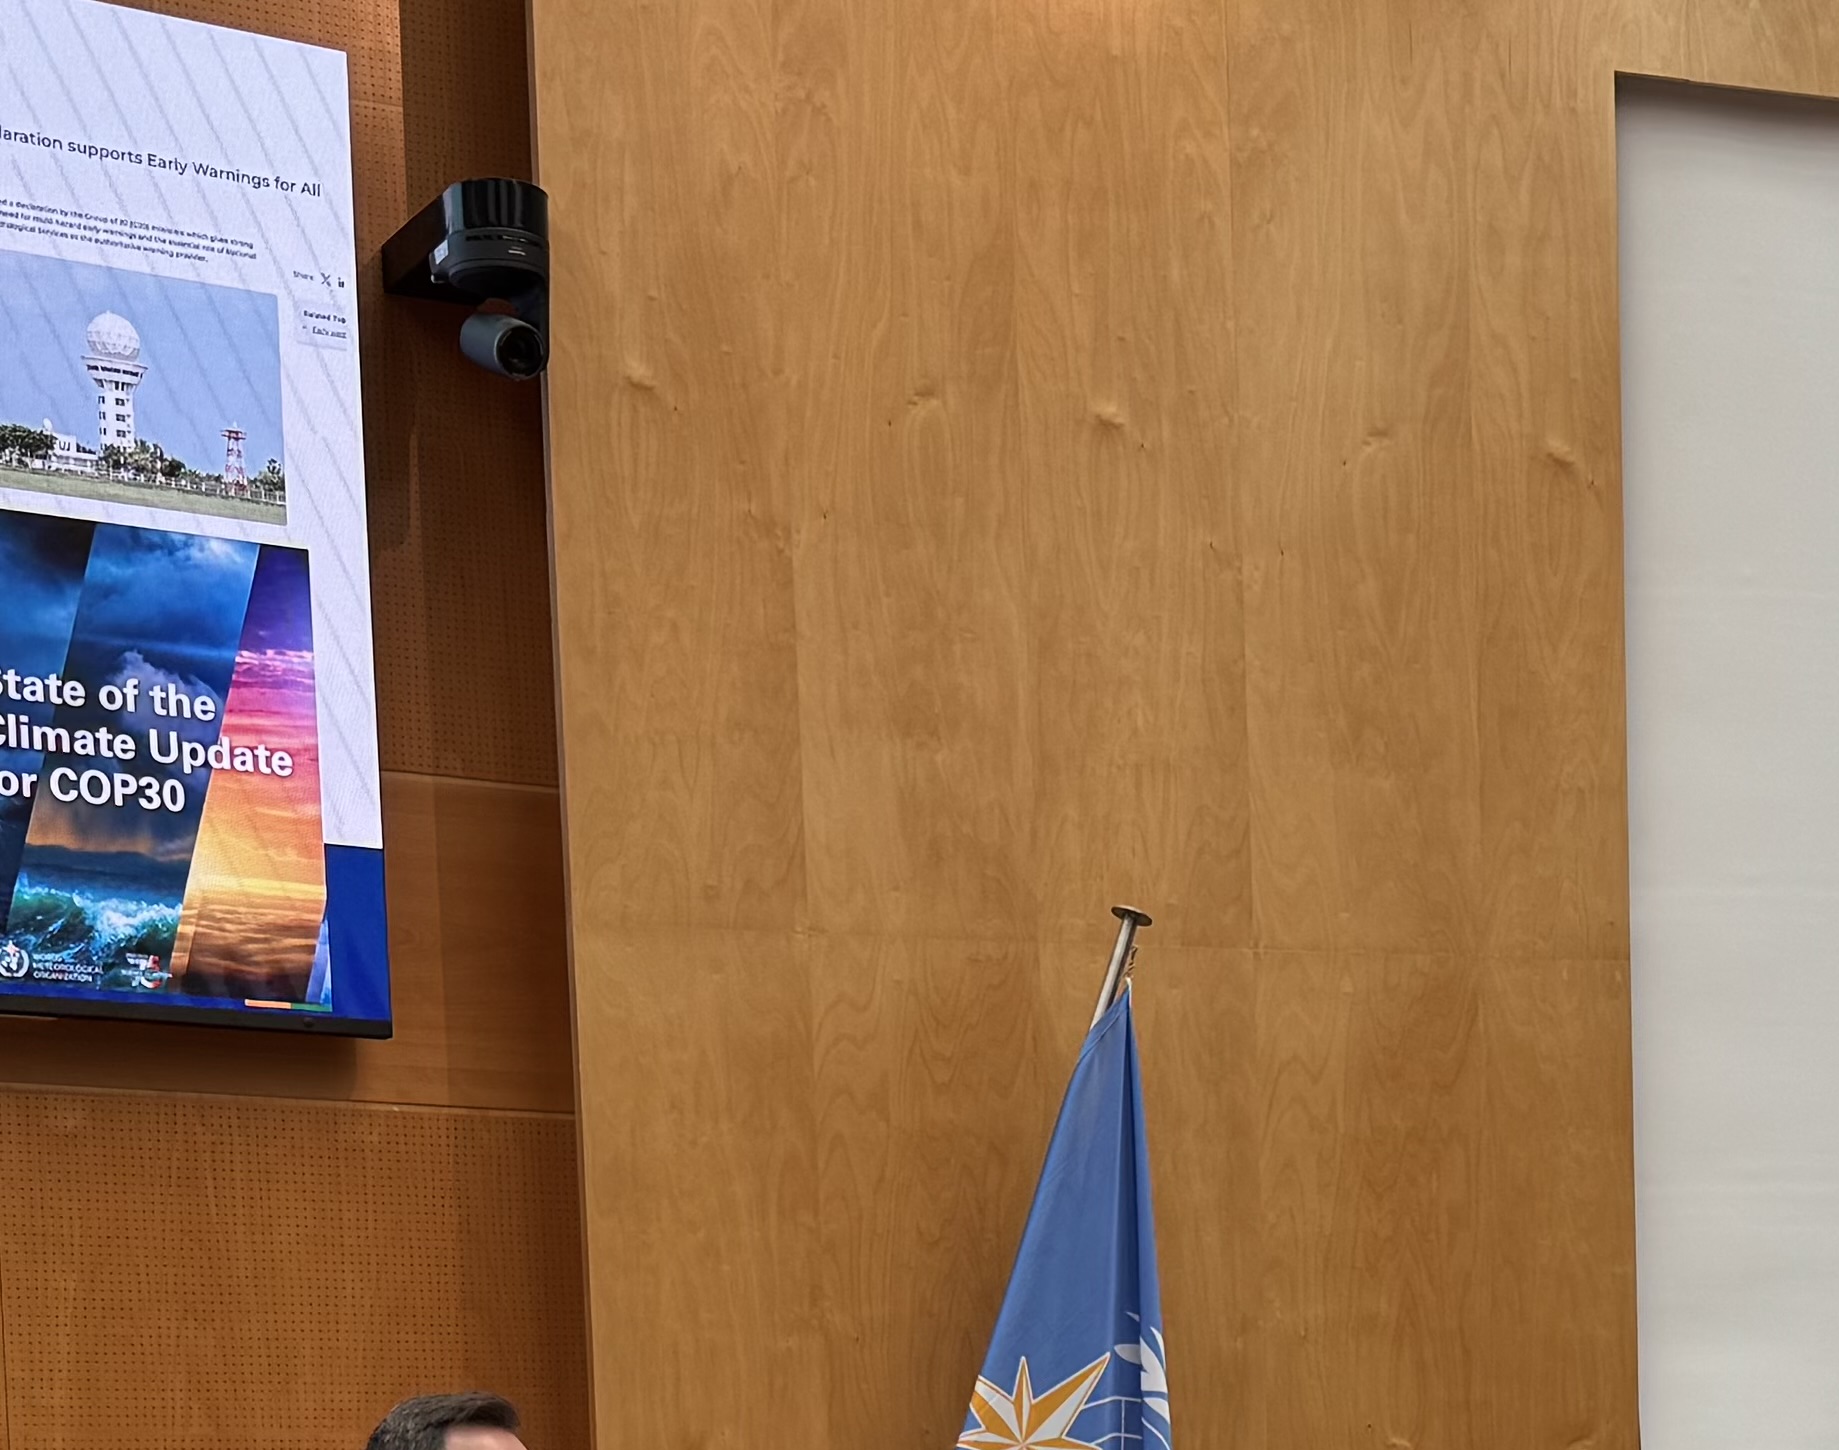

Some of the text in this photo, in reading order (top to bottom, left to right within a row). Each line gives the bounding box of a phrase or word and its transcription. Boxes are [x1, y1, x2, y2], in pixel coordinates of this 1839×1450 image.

[68, 141, 143, 164] supports
[148, 152, 188, 175] Early
[192, 161, 270, 189] Warnings
[274, 176, 296, 192] for
[300, 182, 321, 197] All
[0, 668, 216, 722] tate of the
[149, 728, 294, 777] Update
[49, 766, 186, 813] COP30
